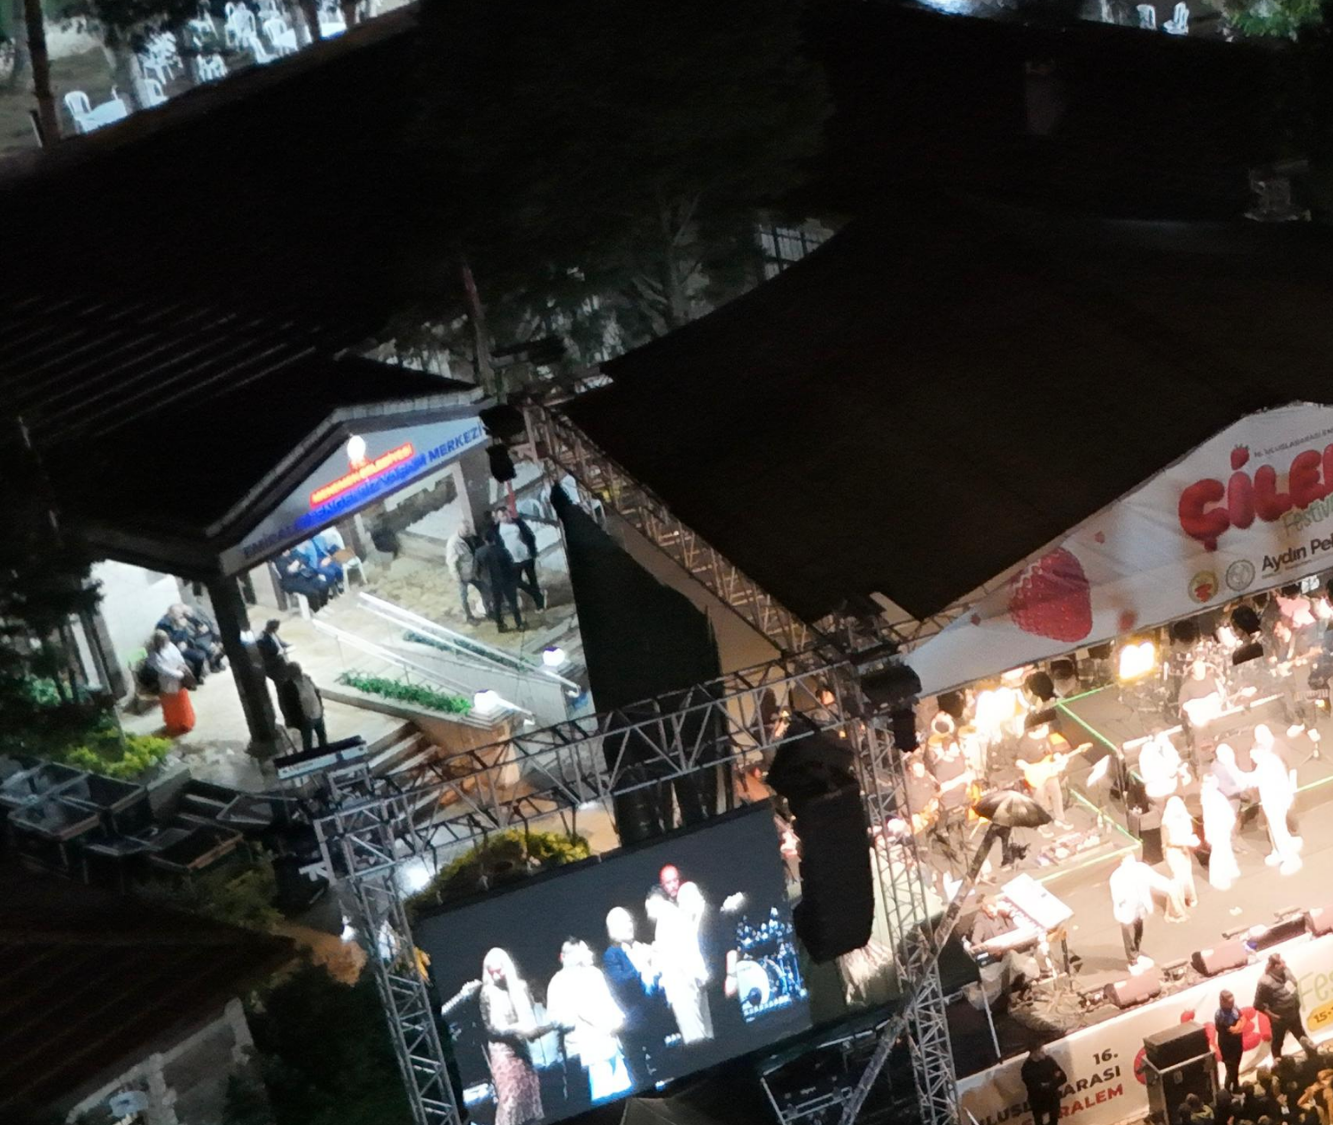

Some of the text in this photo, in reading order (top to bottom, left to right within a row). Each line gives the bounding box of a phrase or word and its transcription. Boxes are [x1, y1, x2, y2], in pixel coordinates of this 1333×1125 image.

[428, 421, 484, 463] MERKEZİ
[1261, 543, 1307, 572] Aydın
[1093, 1048, 1119, 1065] 16.
